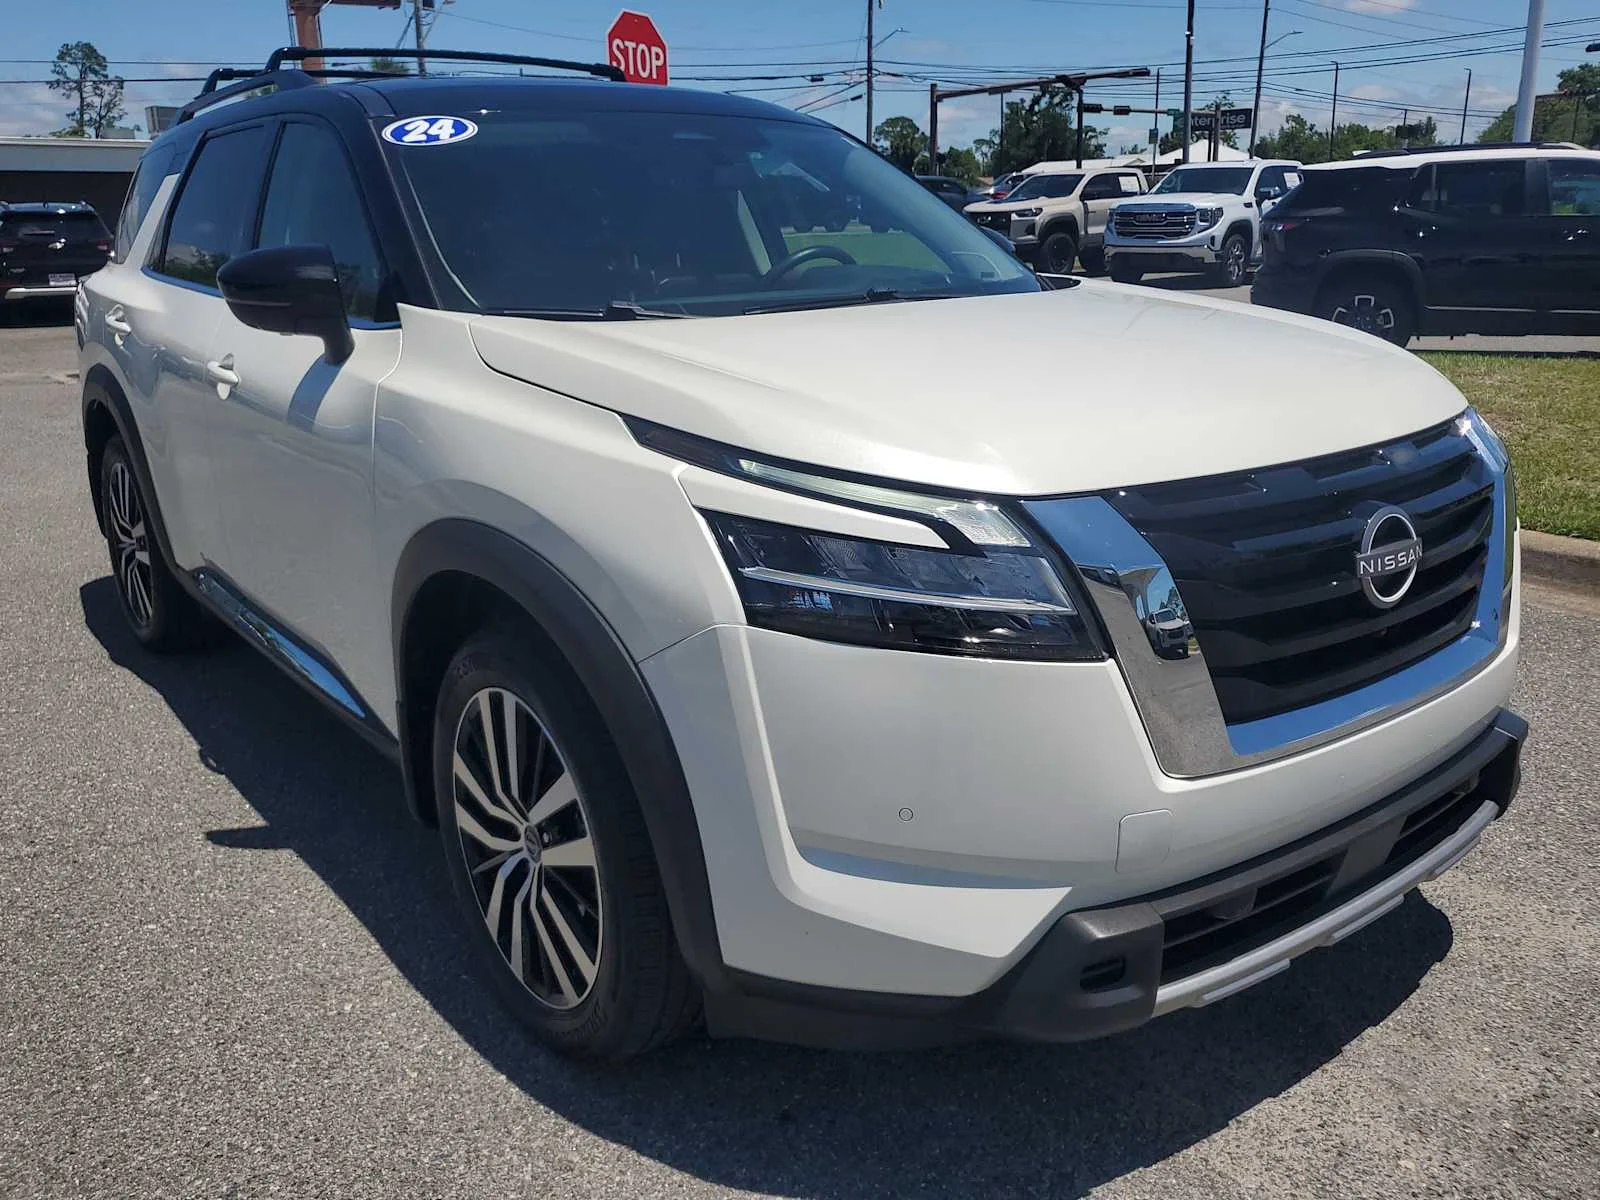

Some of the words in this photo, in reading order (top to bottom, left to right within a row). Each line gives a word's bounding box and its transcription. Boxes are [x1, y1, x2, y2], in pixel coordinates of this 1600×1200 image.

[612, 38, 664, 79] STOP
[402, 119, 455, 142] 24
[1359, 543, 1423, 574] NISSAN
